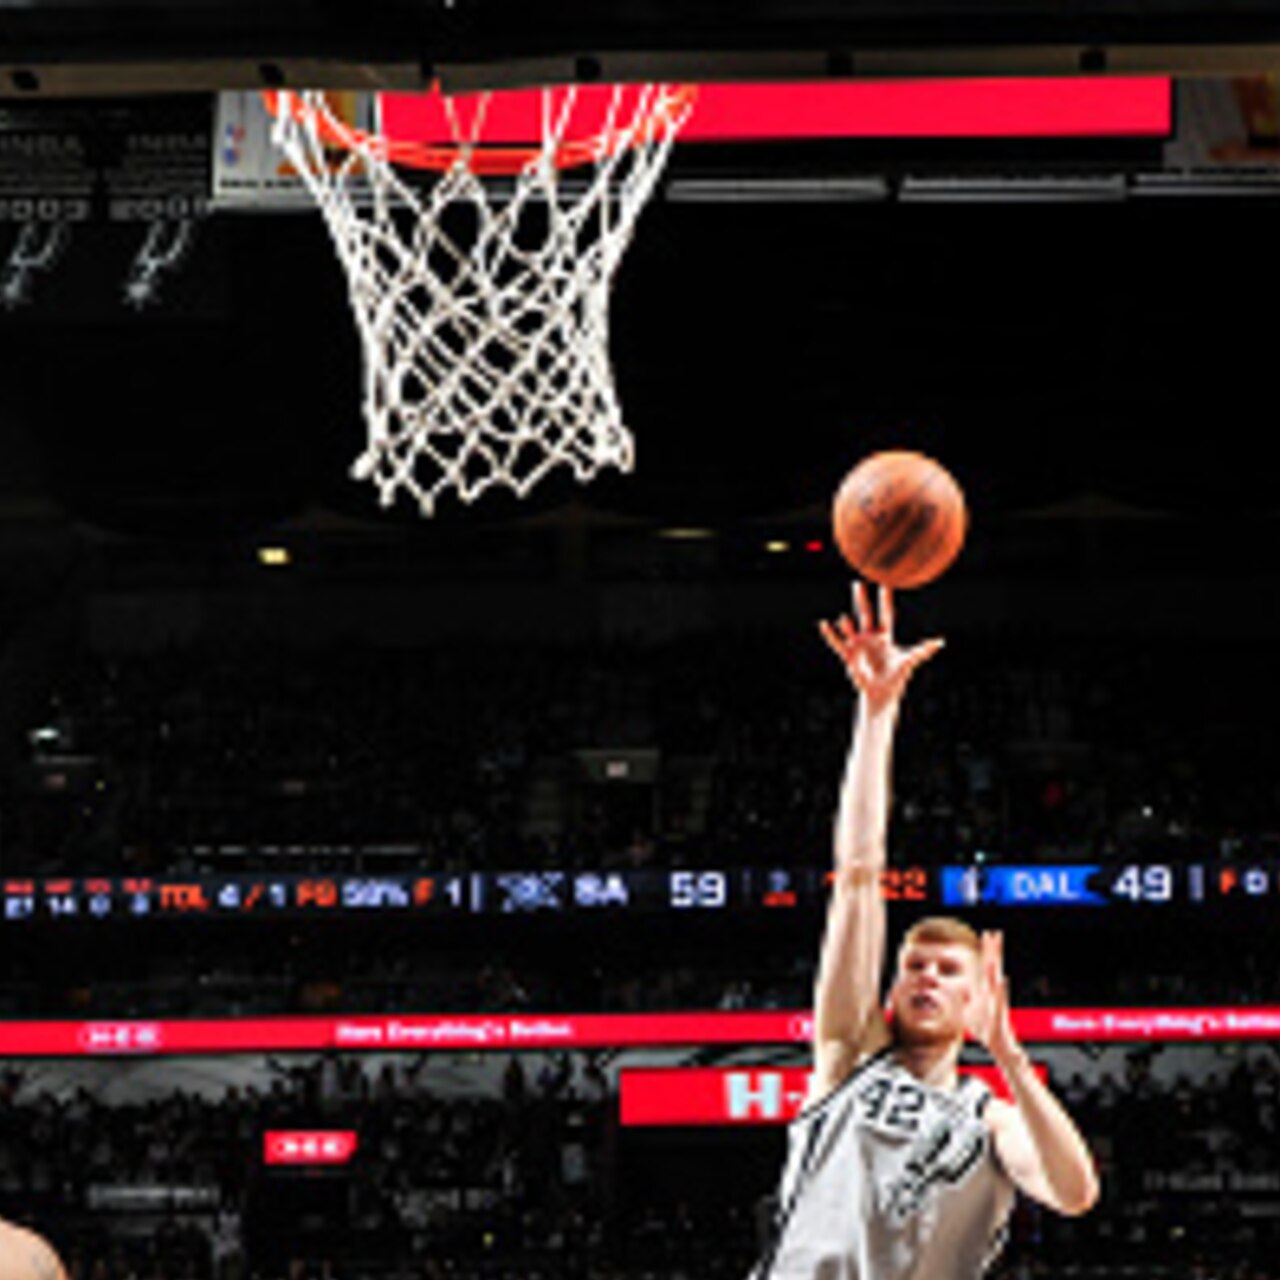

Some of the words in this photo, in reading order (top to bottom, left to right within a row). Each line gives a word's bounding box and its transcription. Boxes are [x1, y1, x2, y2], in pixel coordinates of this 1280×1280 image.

[574, 873, 628, 906] SA
[670, 871, 726, 907] 59
[1014, 872, 1080, 900] DAL
[1112, 865, 1173, 901] 49
[860, 1080, 925, 1129] 42
